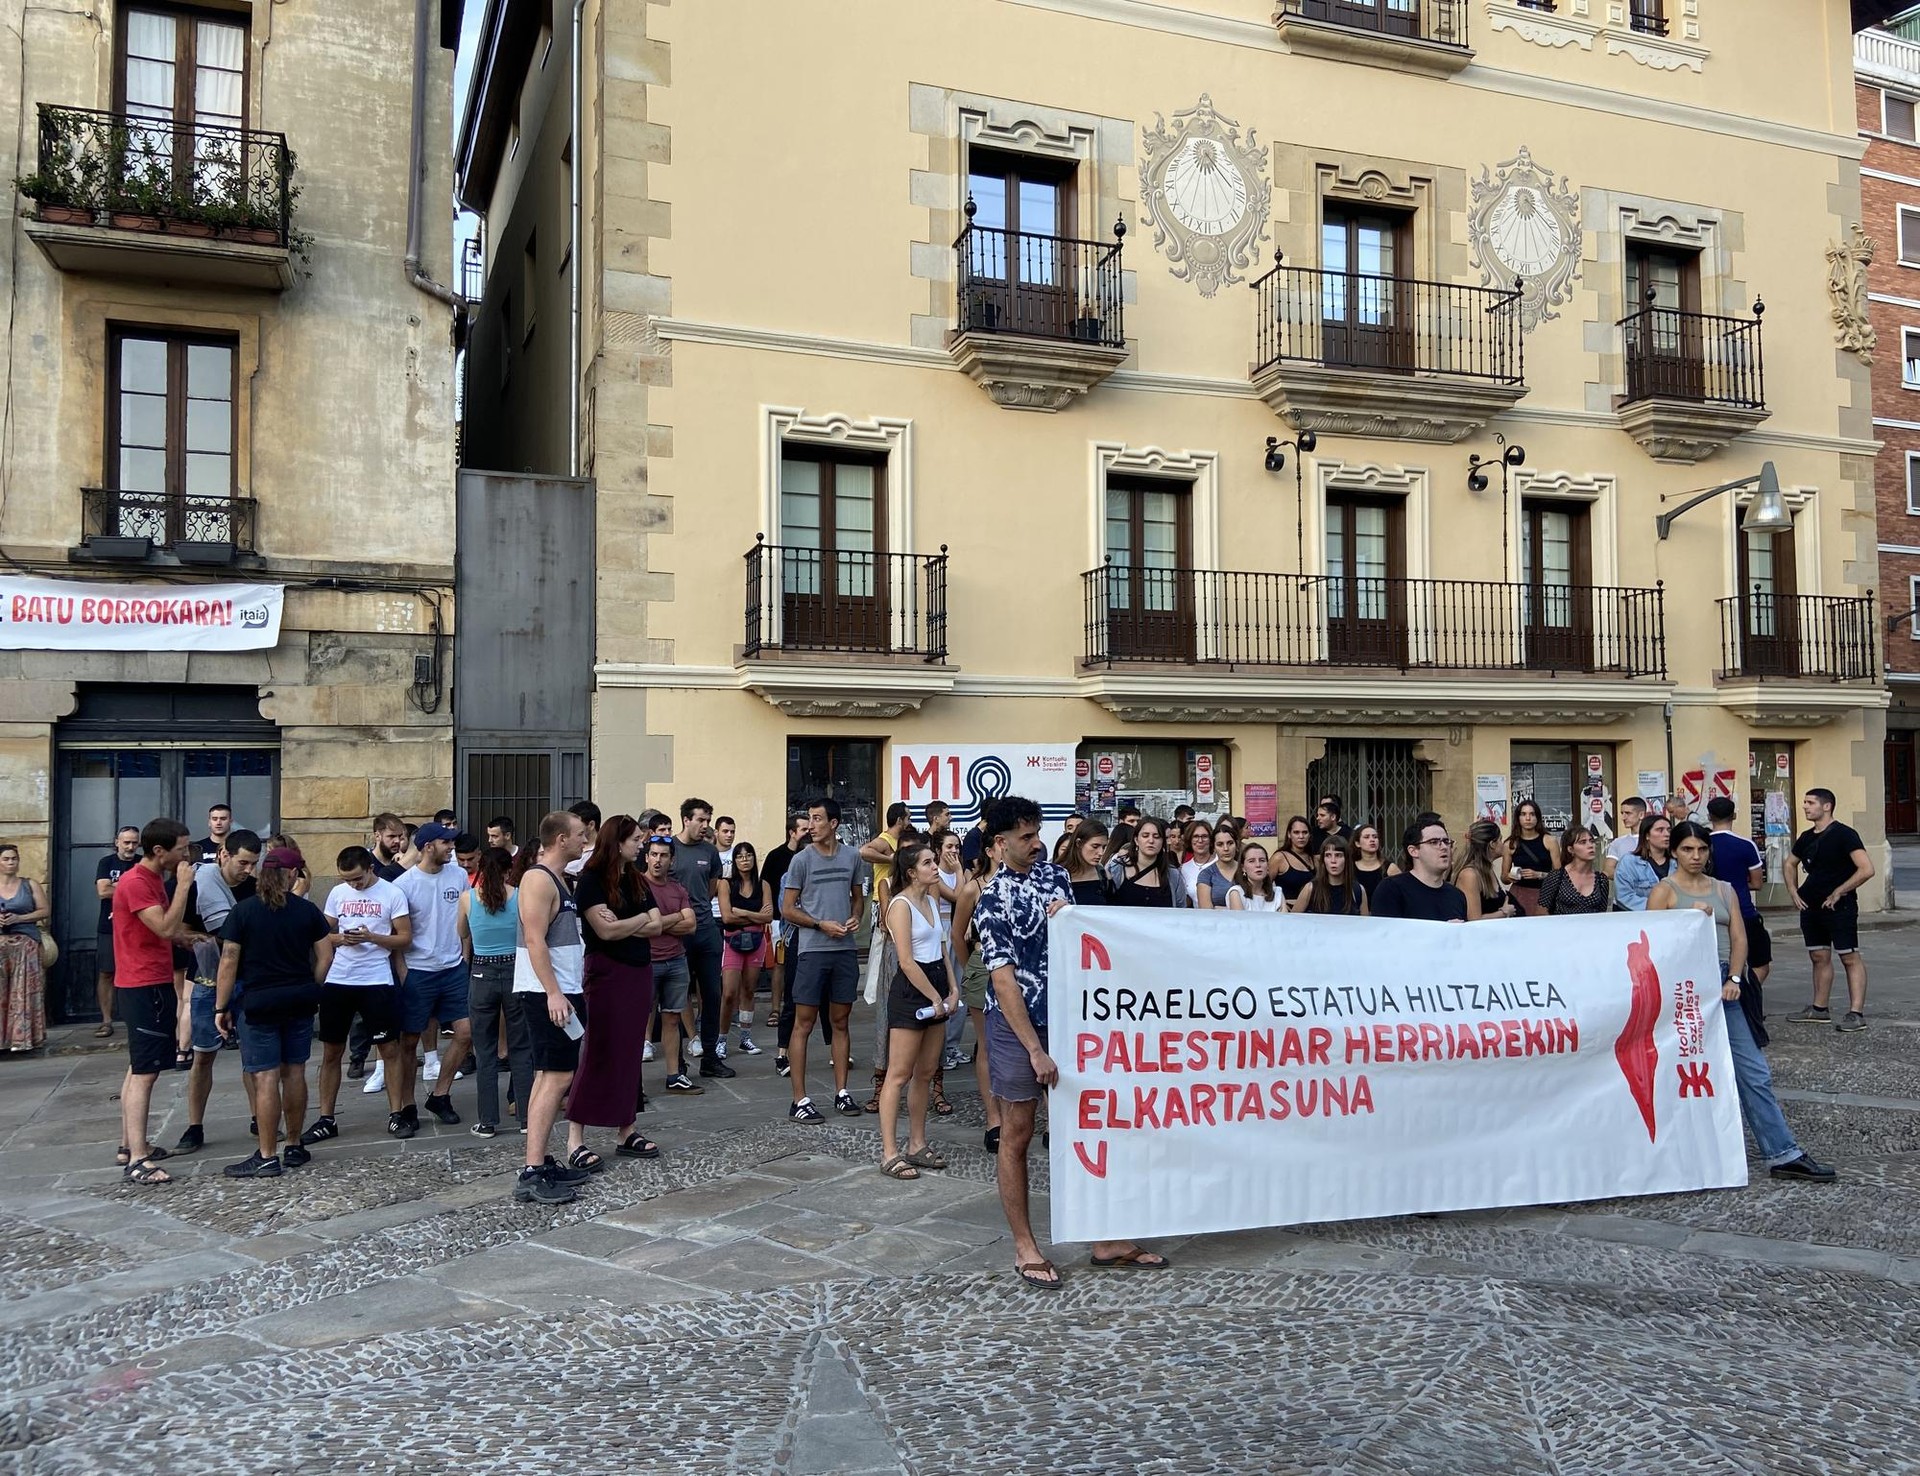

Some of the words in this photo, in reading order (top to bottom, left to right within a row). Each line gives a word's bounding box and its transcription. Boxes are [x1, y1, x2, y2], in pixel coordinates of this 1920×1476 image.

[1170, 198, 1179, 211] X
[1180, 212, 1192, 227] XI
[1195, 221, 1211, 234] XII
[1495, 243, 1504, 254] X
[1503, 254, 1515, 269] XI
[1519, 263, 1530, 274] XII
[12, 595, 73, 624] BATU
[82, 598, 232, 626] BORROKARA!
[240, 609, 265, 620] itaia
[1083, 986, 1257, 1021] ISRAELGO
[1268, 986, 1400, 1017] ESTATUA
[1405, 981, 1566, 1012] HILTZAILEA
[1673, 982, 1688, 1057] Kontseilu
[1077, 1027, 1332, 1073] PALESTINAR
[1344, 1018, 1580, 1064] HERRIAREKIN
[1079, 1075, 1374, 1129] ELKARTASUNA
